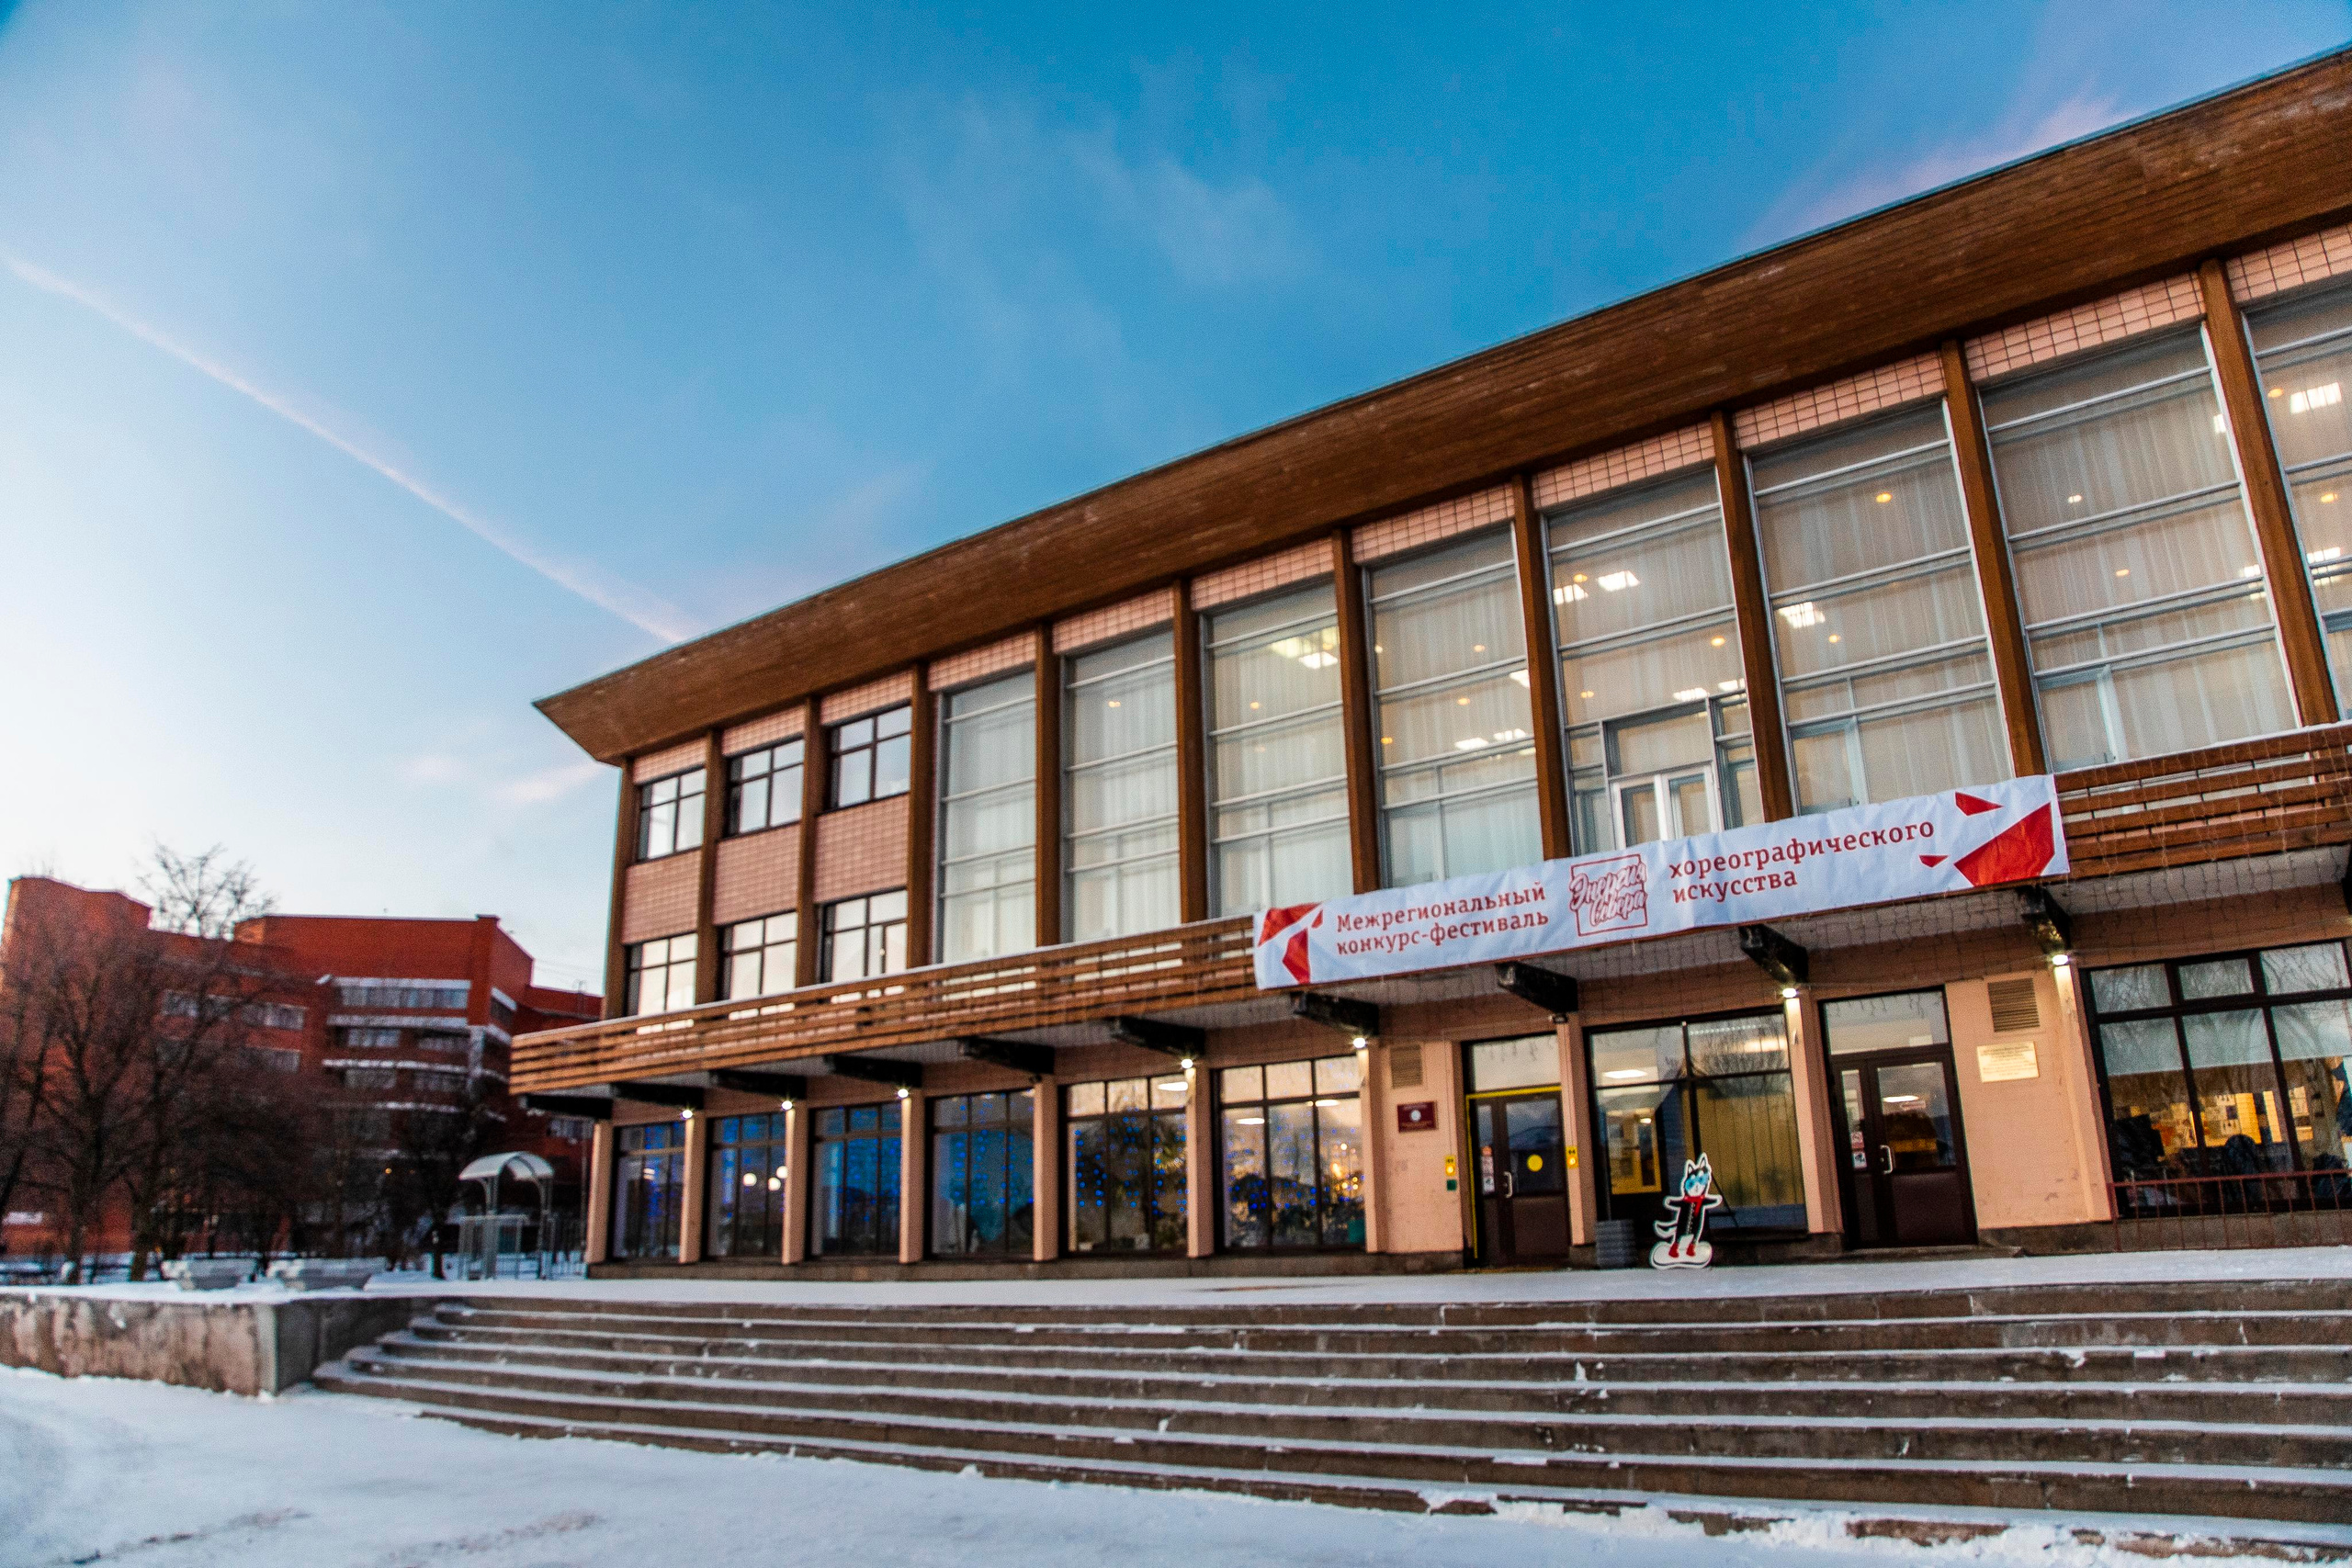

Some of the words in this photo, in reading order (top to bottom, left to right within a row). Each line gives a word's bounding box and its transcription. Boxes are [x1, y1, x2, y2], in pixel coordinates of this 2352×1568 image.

[1668, 821, 1935, 878] хореографического
[1337, 881, 1545, 932] Межрегиональный
[1673, 870, 1798, 903] искусства
[1337, 911, 1549, 955] конкурс-фестиваль
